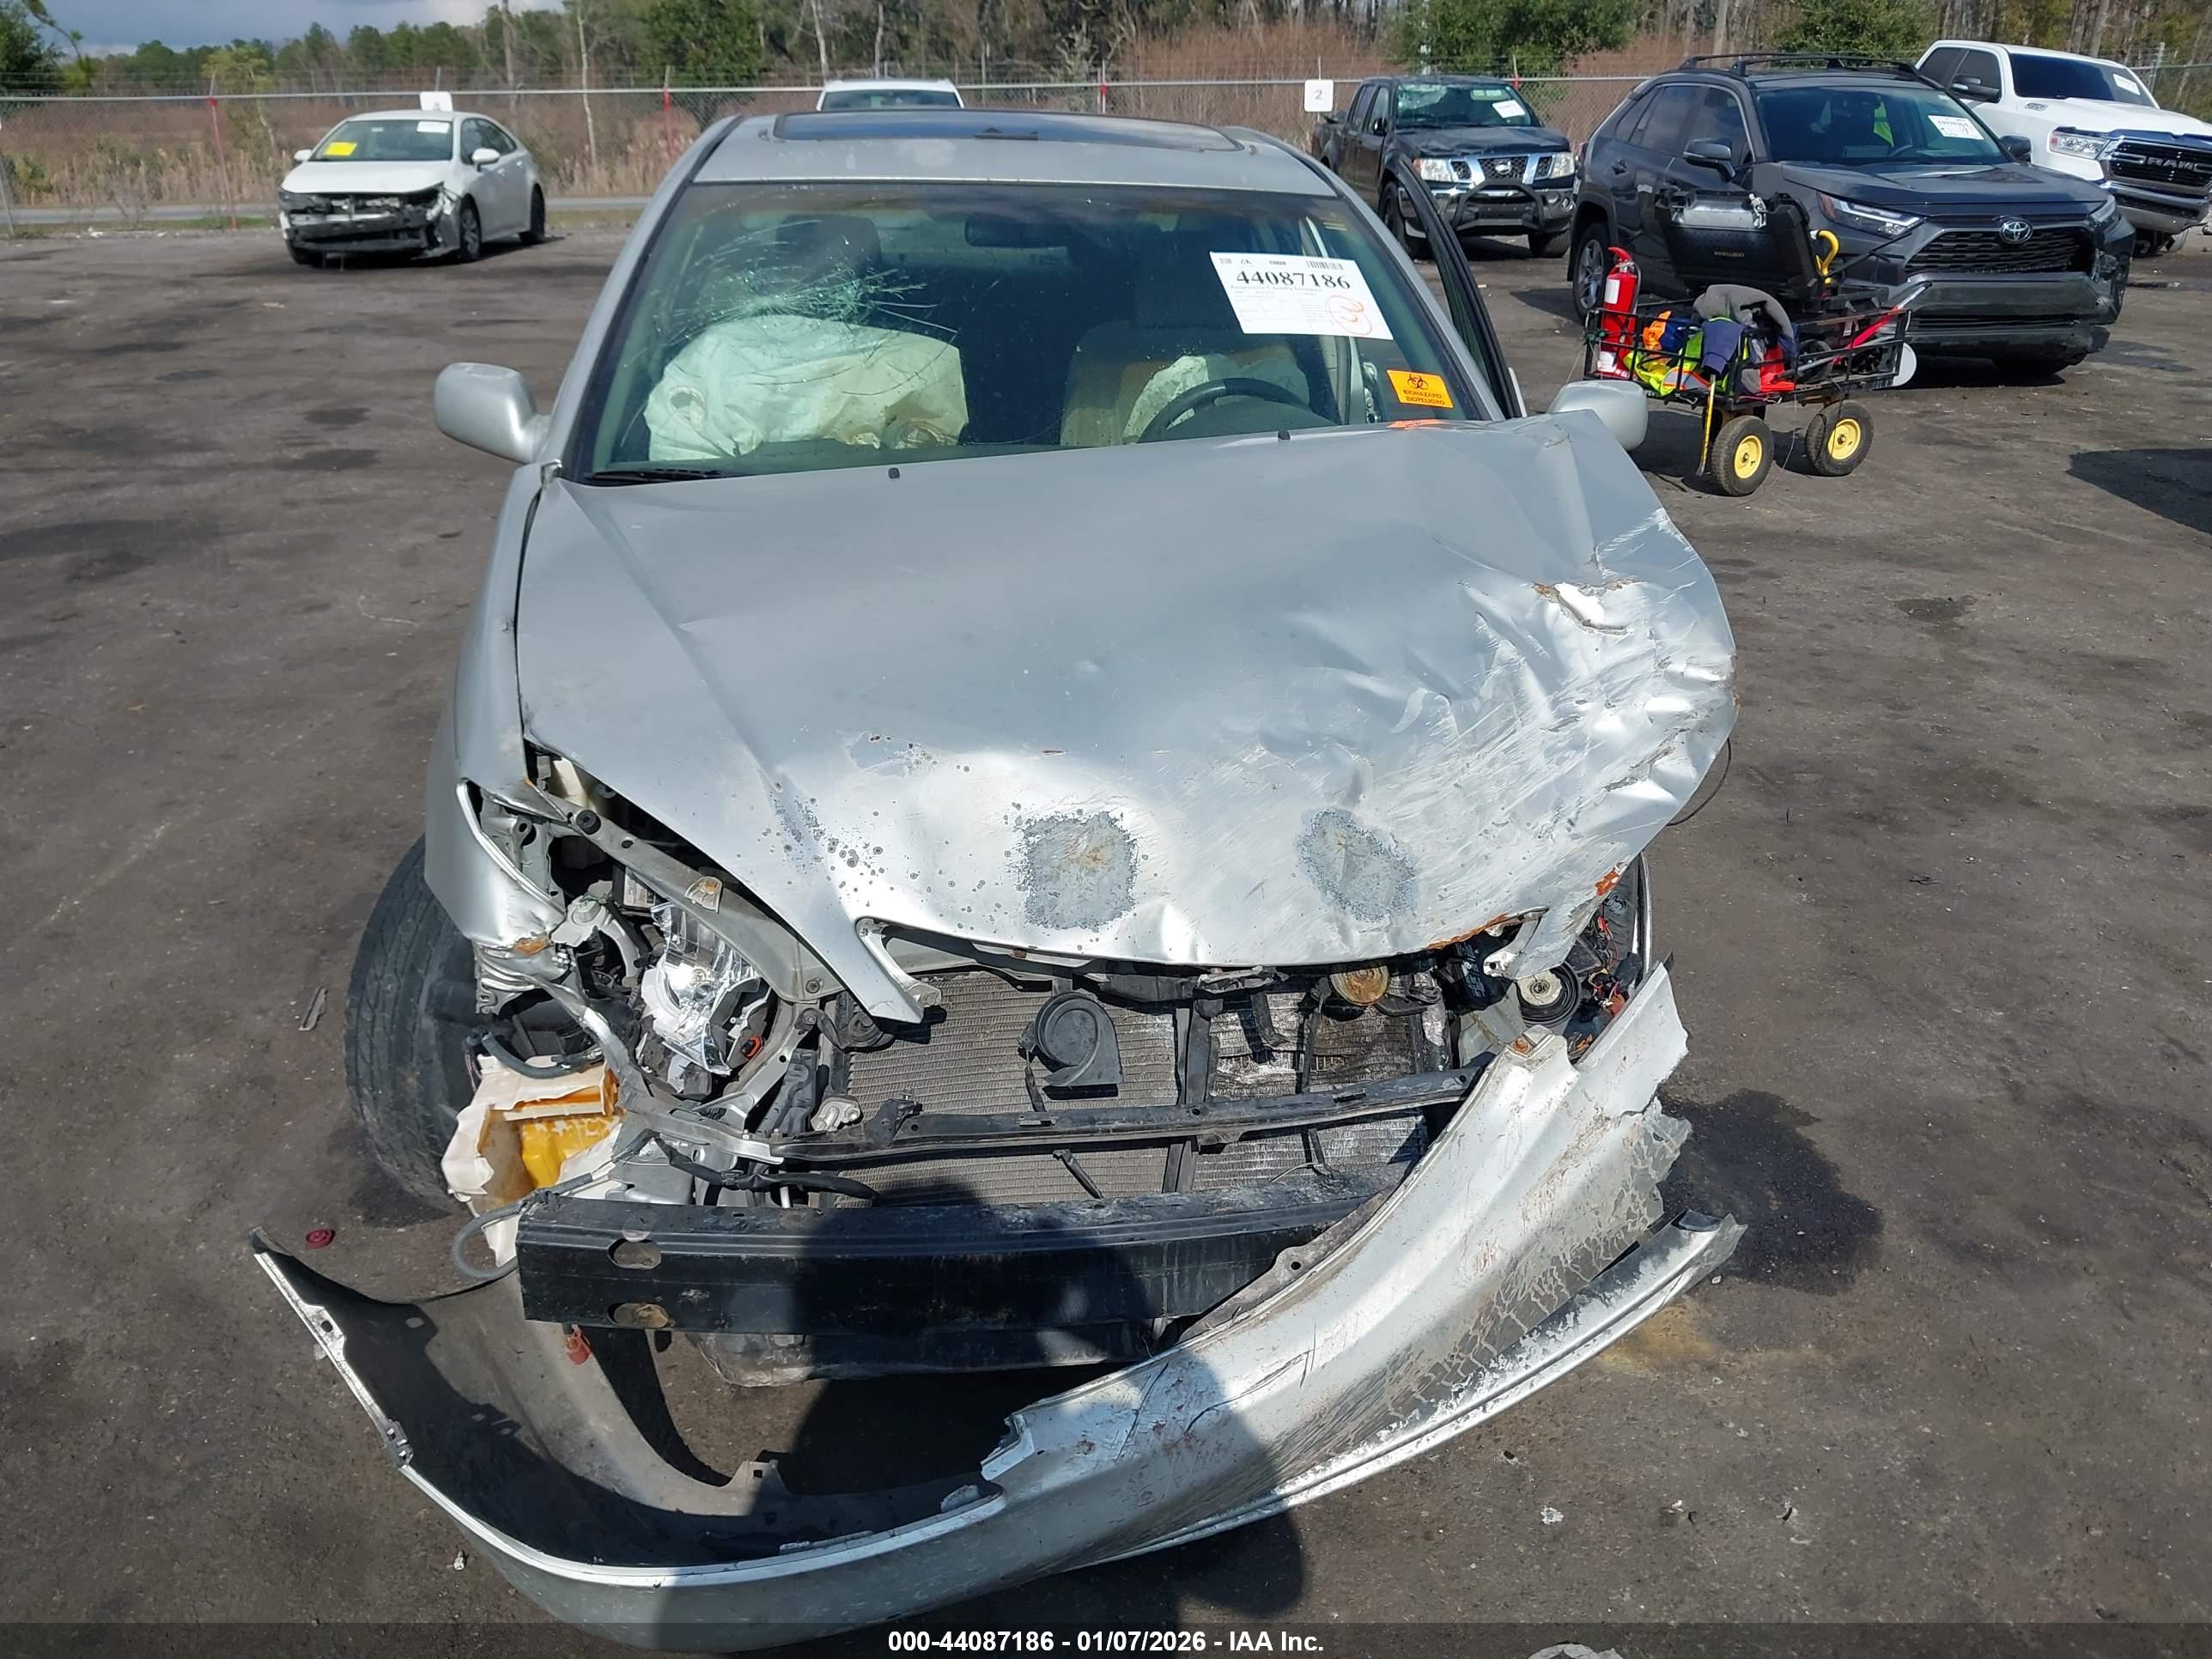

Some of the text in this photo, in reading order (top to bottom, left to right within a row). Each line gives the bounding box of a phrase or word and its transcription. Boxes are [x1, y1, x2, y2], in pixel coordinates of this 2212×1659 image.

[1315, 89, 1322, 100] 2
[2147, 157, 2193, 171] RAM
[1237, 270, 1351, 289] 44087186
[1403, 390, 1443, 398] BIOHAZARD
[1406, 396, 1445, 405] BIOPELIGRO
